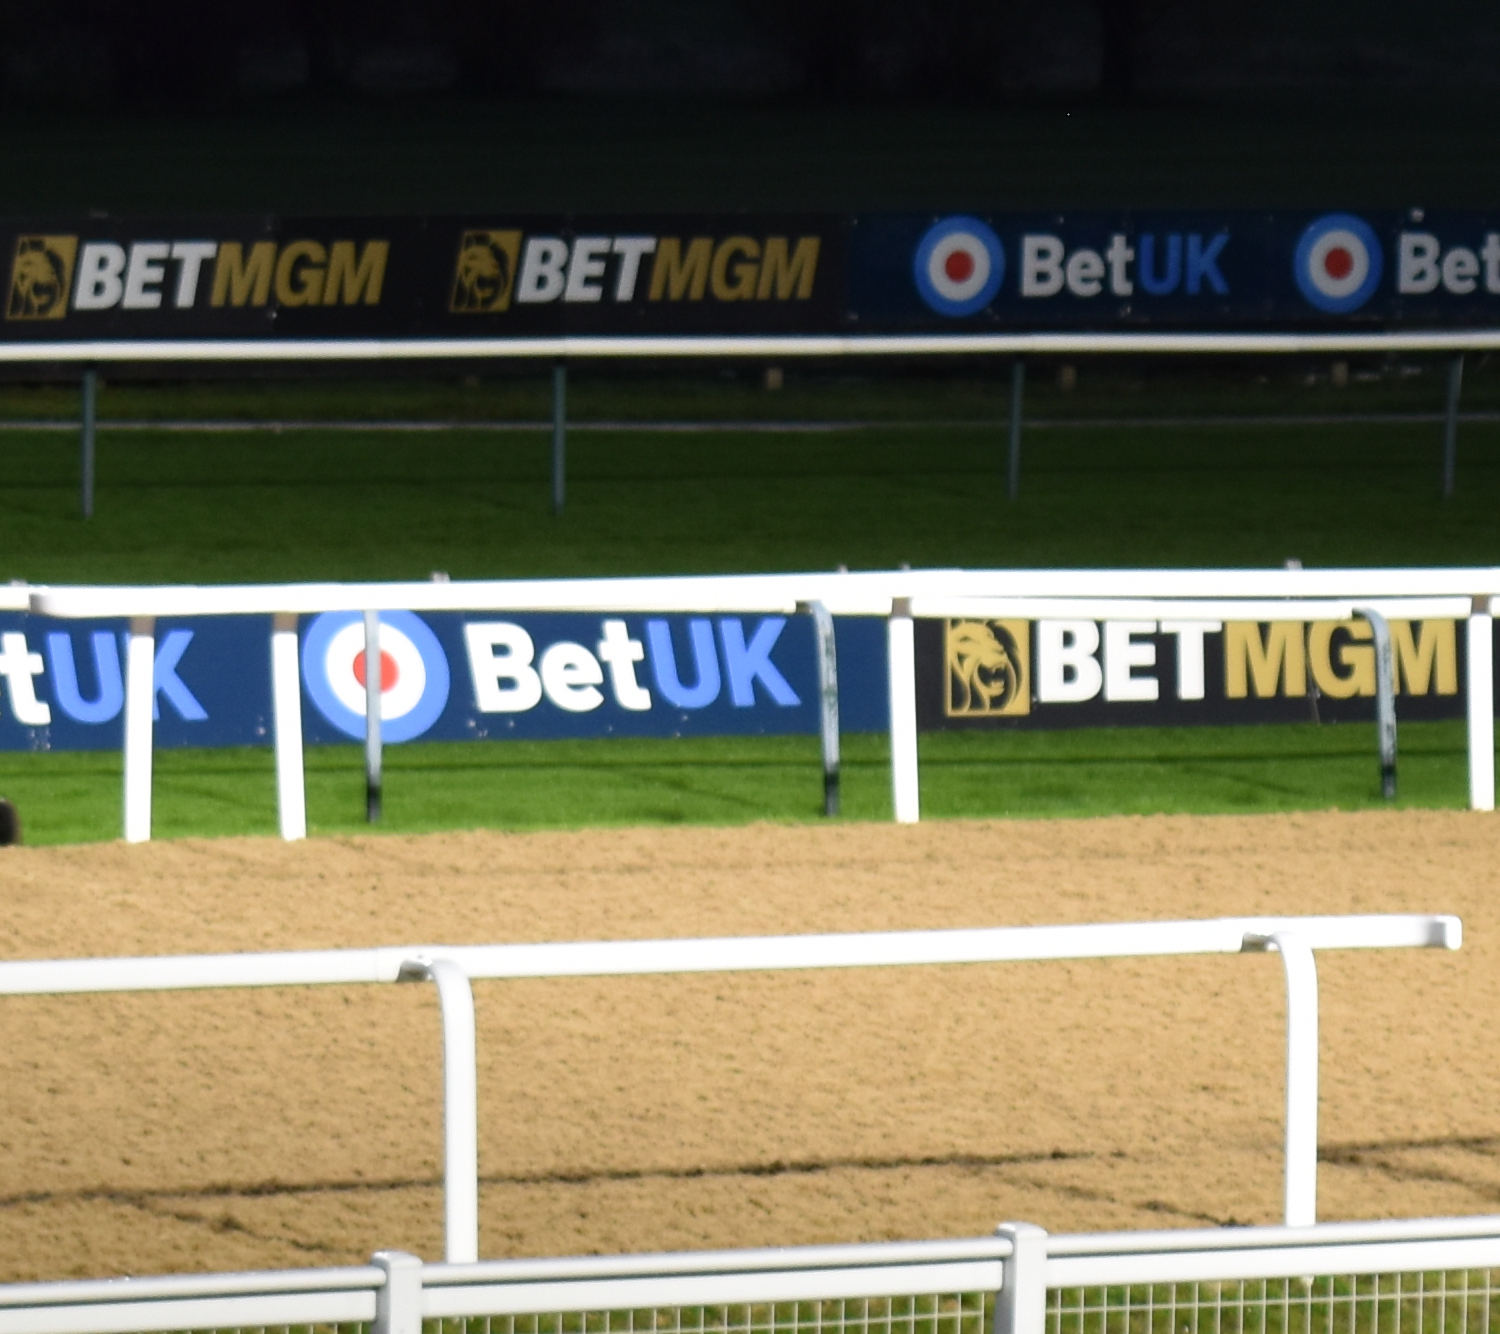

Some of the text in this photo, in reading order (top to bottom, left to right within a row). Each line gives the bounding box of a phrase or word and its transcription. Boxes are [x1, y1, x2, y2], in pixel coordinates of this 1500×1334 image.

[74, 236, 388, 310] BETMGM
[517, 236, 820, 302] BETMGM
[1020, 233, 1229, 296] BetUK
[463, 617, 800, 713] BetUK
[1038, 620, 1457, 703] BETMGM
